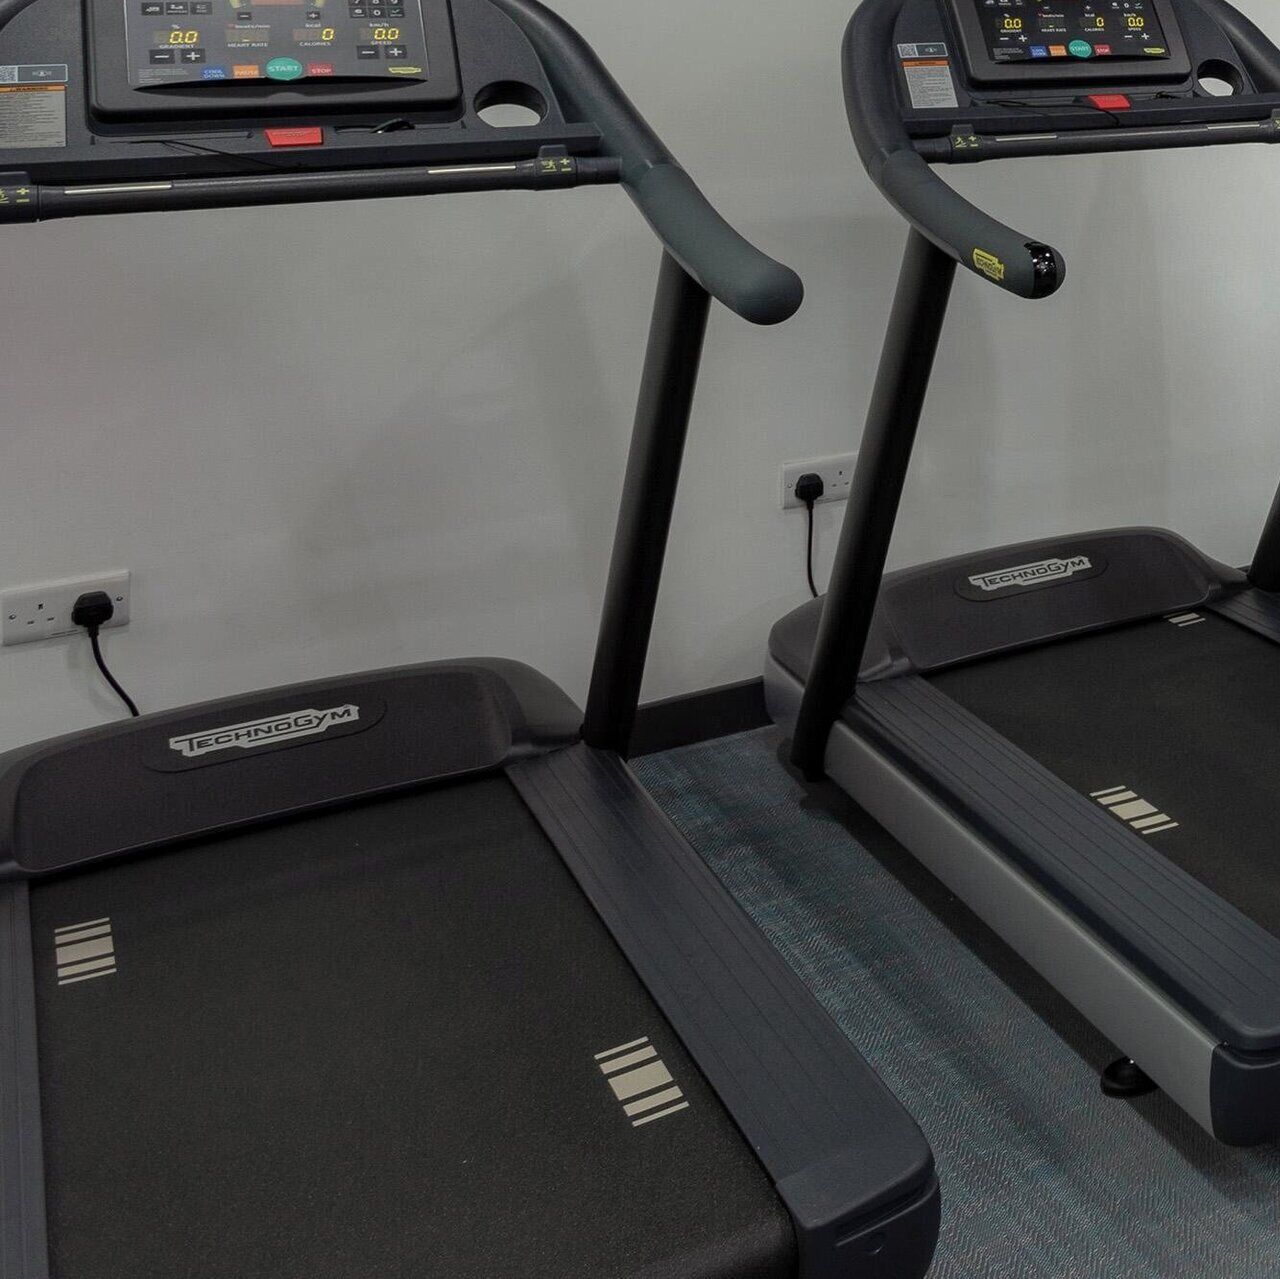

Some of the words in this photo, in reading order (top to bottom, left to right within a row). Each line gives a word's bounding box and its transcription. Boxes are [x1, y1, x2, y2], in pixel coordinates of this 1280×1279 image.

[169, 30, 199, 44] 0.0
[321, 27, 335, 41] 0
[374, 27, 400, 40] 0.0
[268, 65, 299, 73] START
[972, 559, 1086, 588] TECHNOGYM
[174, 708, 351, 752] TECHNOGYM
